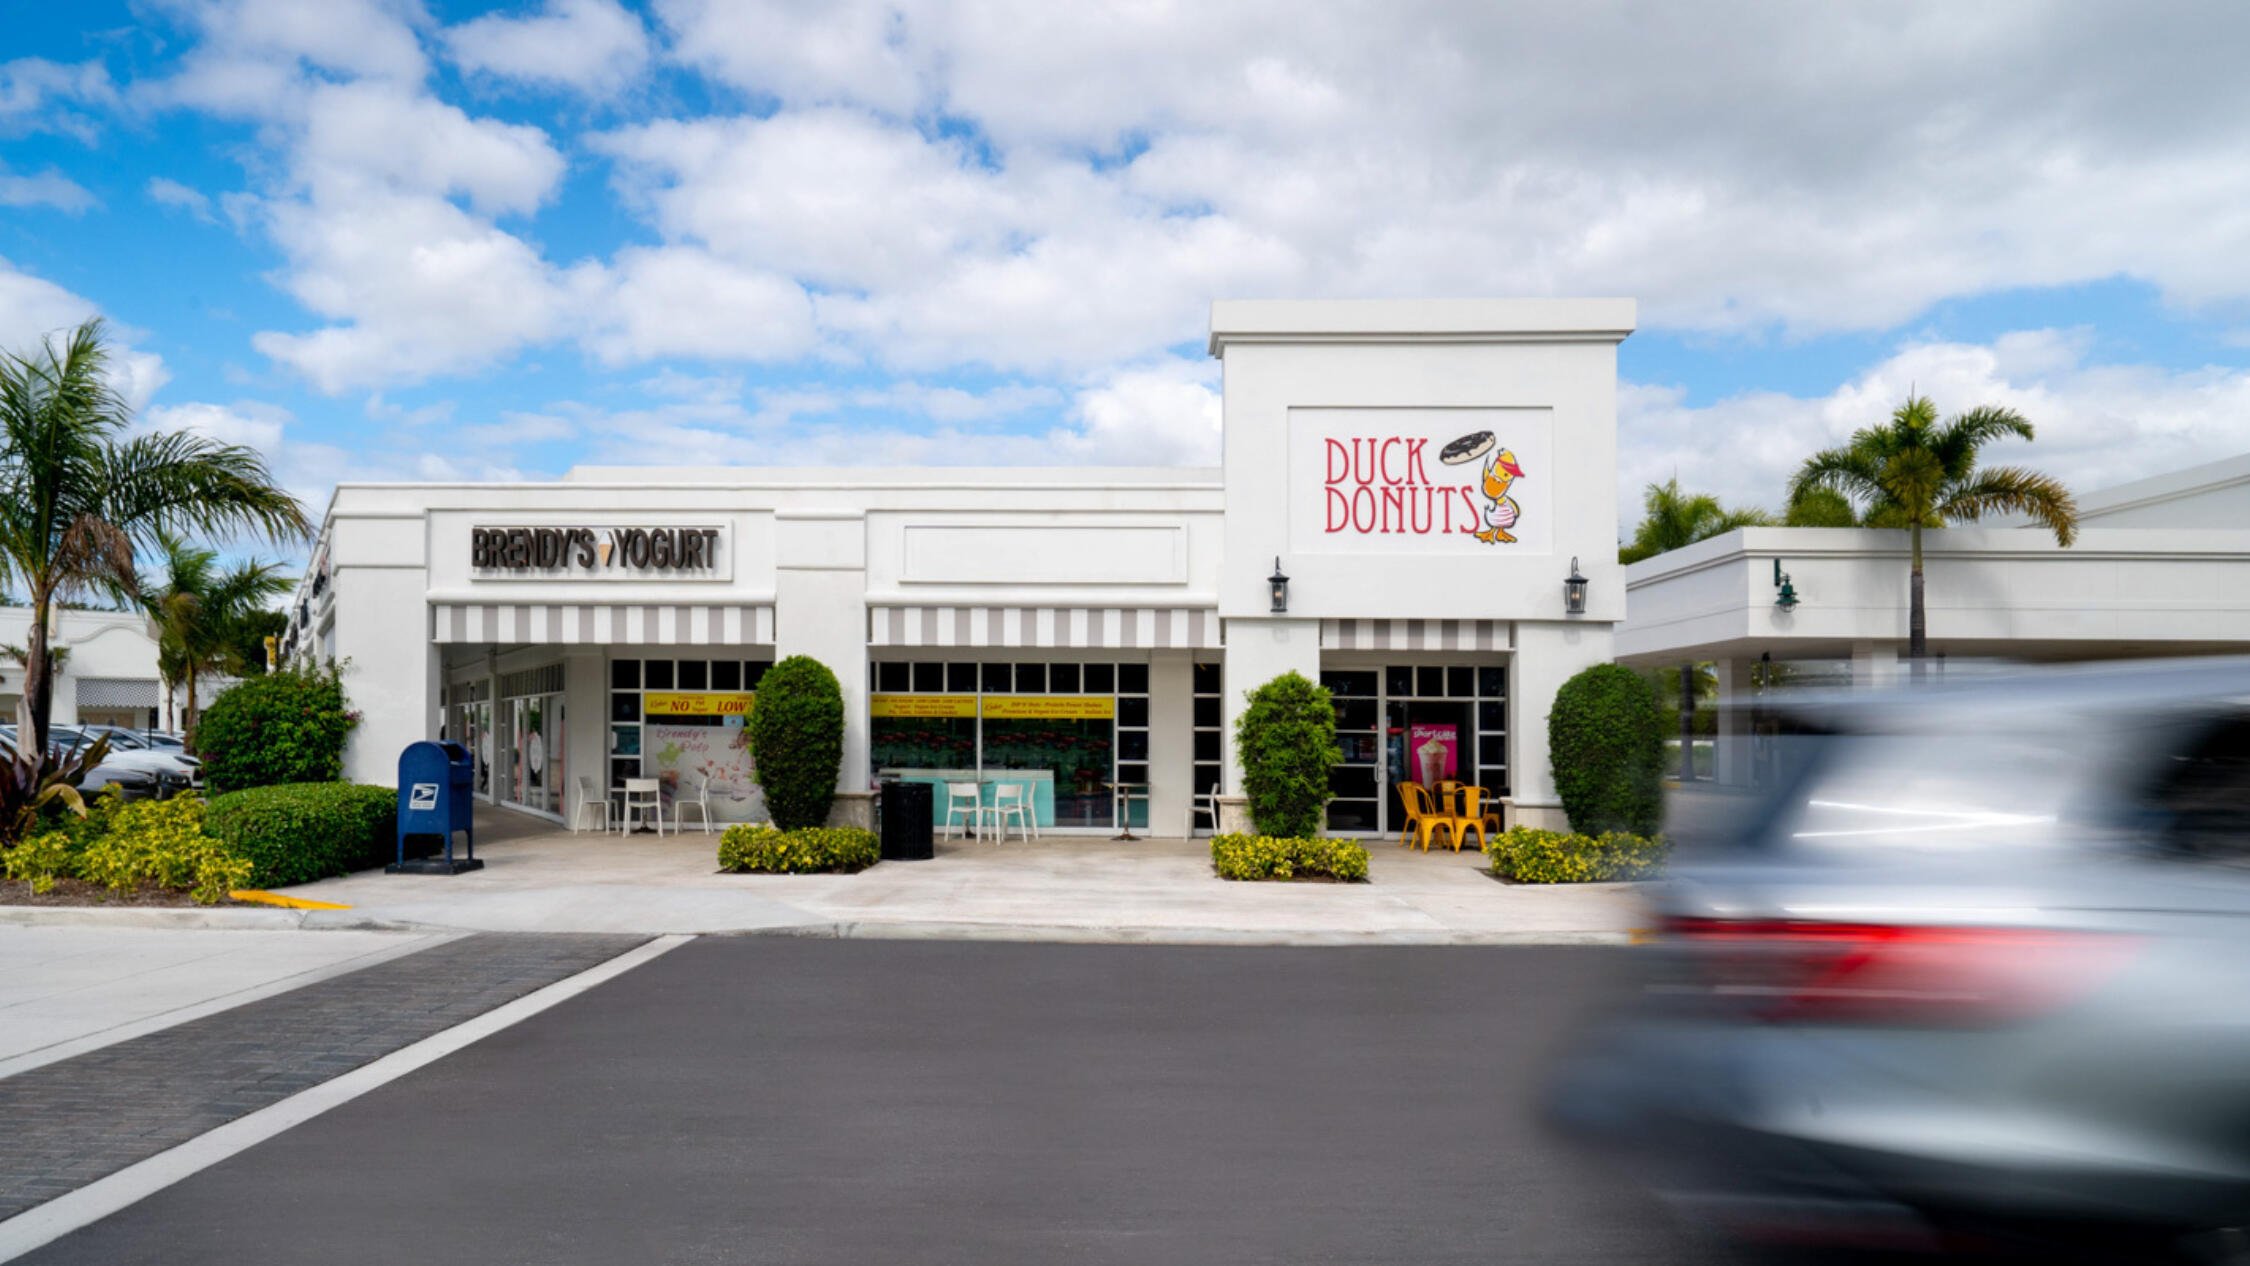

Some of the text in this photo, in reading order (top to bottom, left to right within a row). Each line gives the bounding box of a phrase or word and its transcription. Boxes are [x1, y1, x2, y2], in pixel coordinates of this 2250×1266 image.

[1325, 437, 1430, 485] DUCK
[1325, 485, 1480, 534] DONUTS
[472, 528, 719, 569] BRENDY'S YOGURT
[671, 701, 689, 712] NO
[717, 701, 746, 712] LOW
